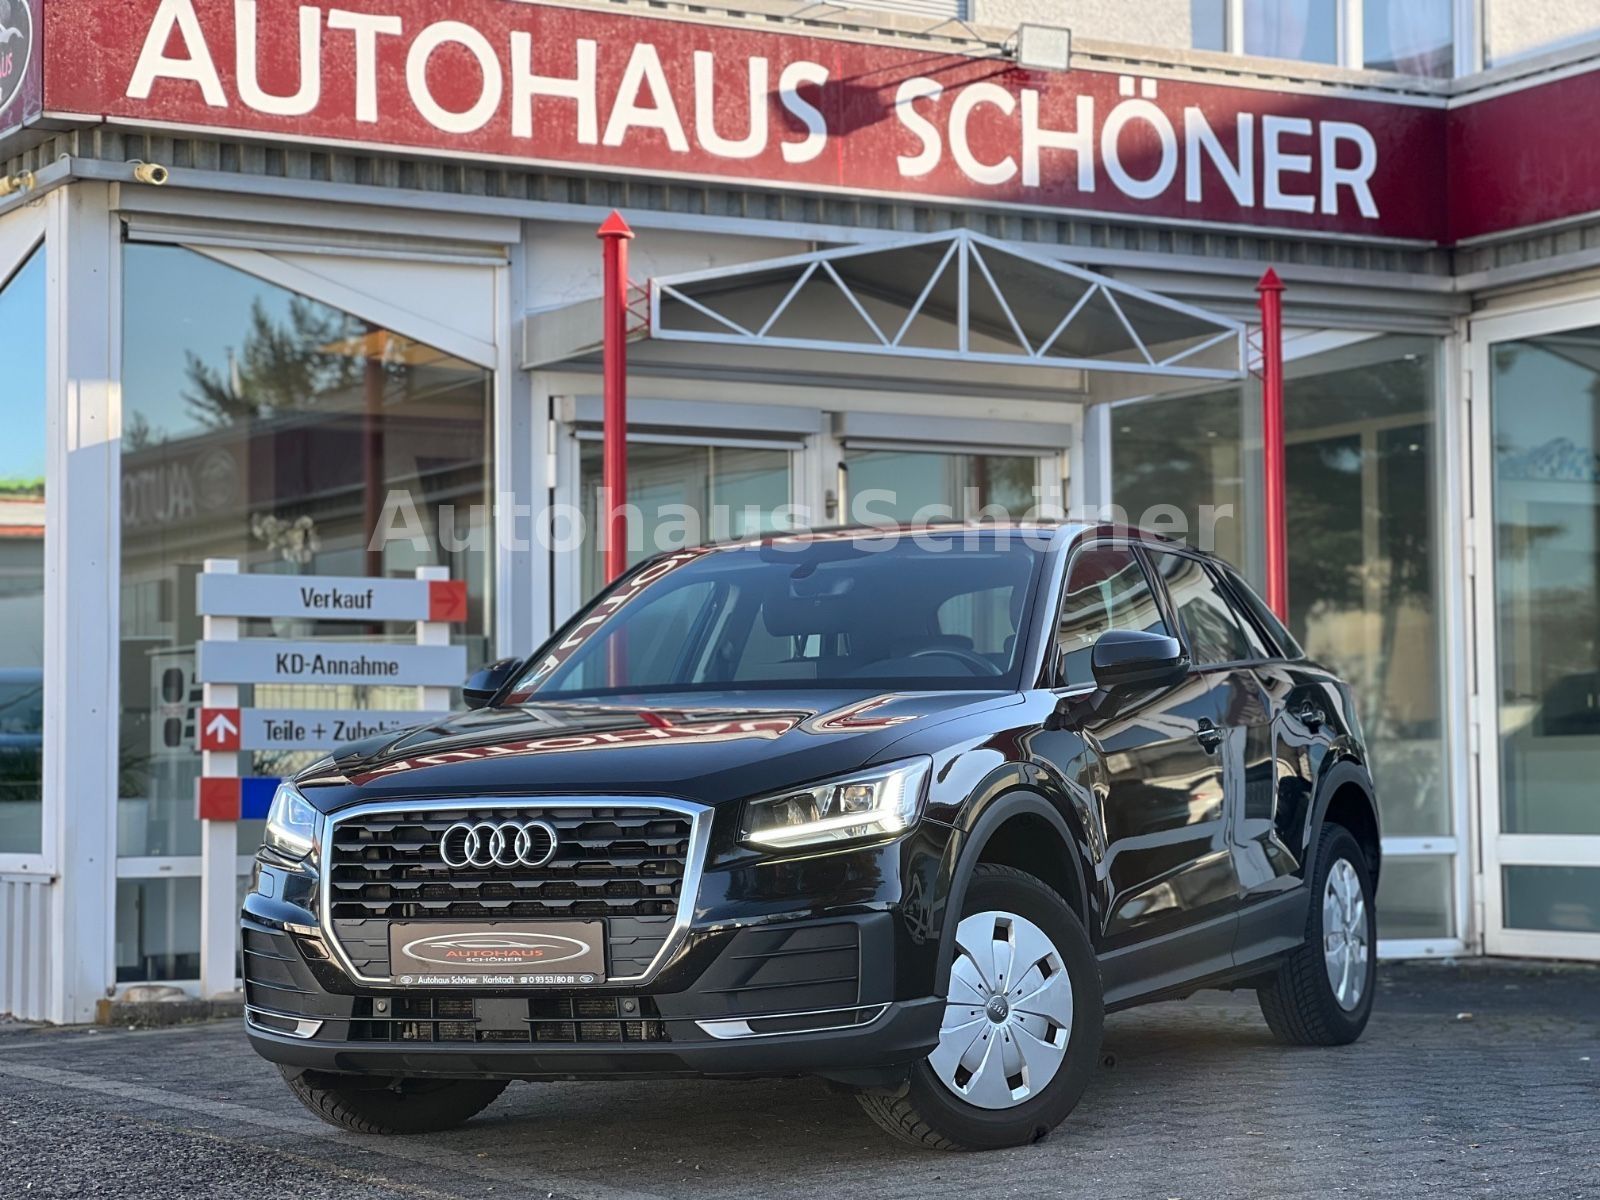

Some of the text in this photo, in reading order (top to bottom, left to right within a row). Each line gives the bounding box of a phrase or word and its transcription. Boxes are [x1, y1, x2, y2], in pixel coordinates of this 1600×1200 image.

[126, 0, 1380, 219] AUTOHAUS SCHÖNER
[300, 587, 373, 609] Verkauf
[276, 653, 399, 676] KD-Annahme
[264, 720, 306, 741] Teile
[312, 724, 327, 738] +
[418, 976, 450, 984] Autohaus
[451, 976, 478, 984] Schöner
[482, 976, 515, 984] Karlstadt
